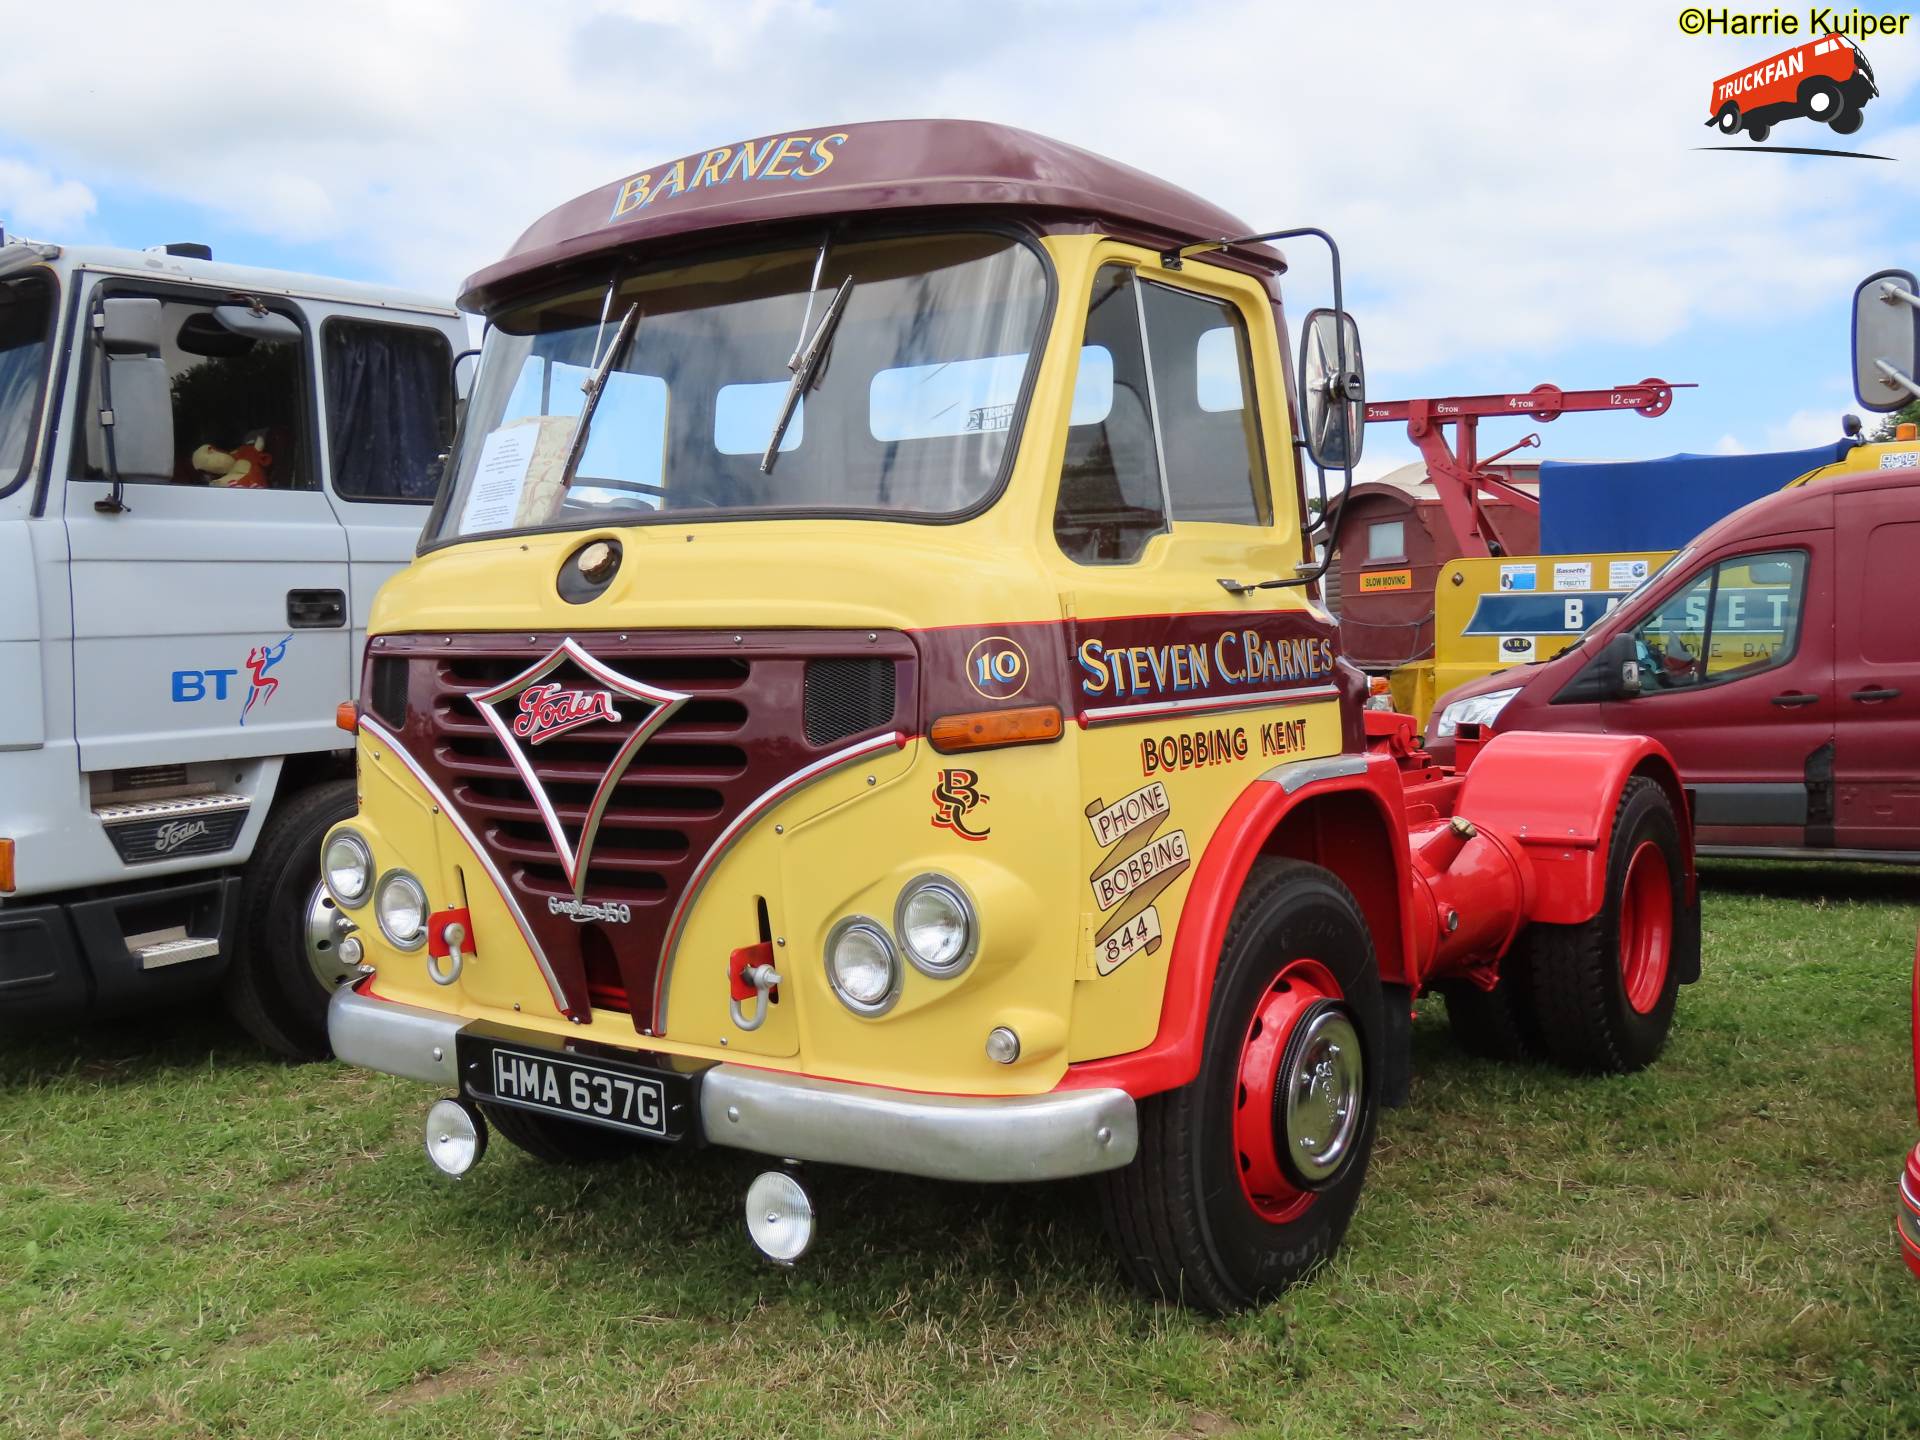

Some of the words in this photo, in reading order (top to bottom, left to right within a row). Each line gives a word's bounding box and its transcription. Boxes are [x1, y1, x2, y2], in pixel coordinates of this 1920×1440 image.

[608, 133, 848, 224] BARNES
[1366, 577, 1381, 587] SLOW
[1383, 575, 1406, 586] MOVING
[172, 669, 238, 702] BT
[977, 649, 1020, 685] 10
[1078, 638, 1209, 697] STEVEN
[514, 683, 622, 744] Foden
[1141, 727, 1248, 776] BOBBING
[1261, 719, 1307, 757] KENT
[155, 819, 209, 852] Foden
[1098, 786, 1165, 842] PHONE
[1102, 835, 1184, 907] BOBBING
[1105, 916, 1150, 964] 844
[498, 1056, 561, 1105] HMA
[569, 1071, 660, 1126] 637G
